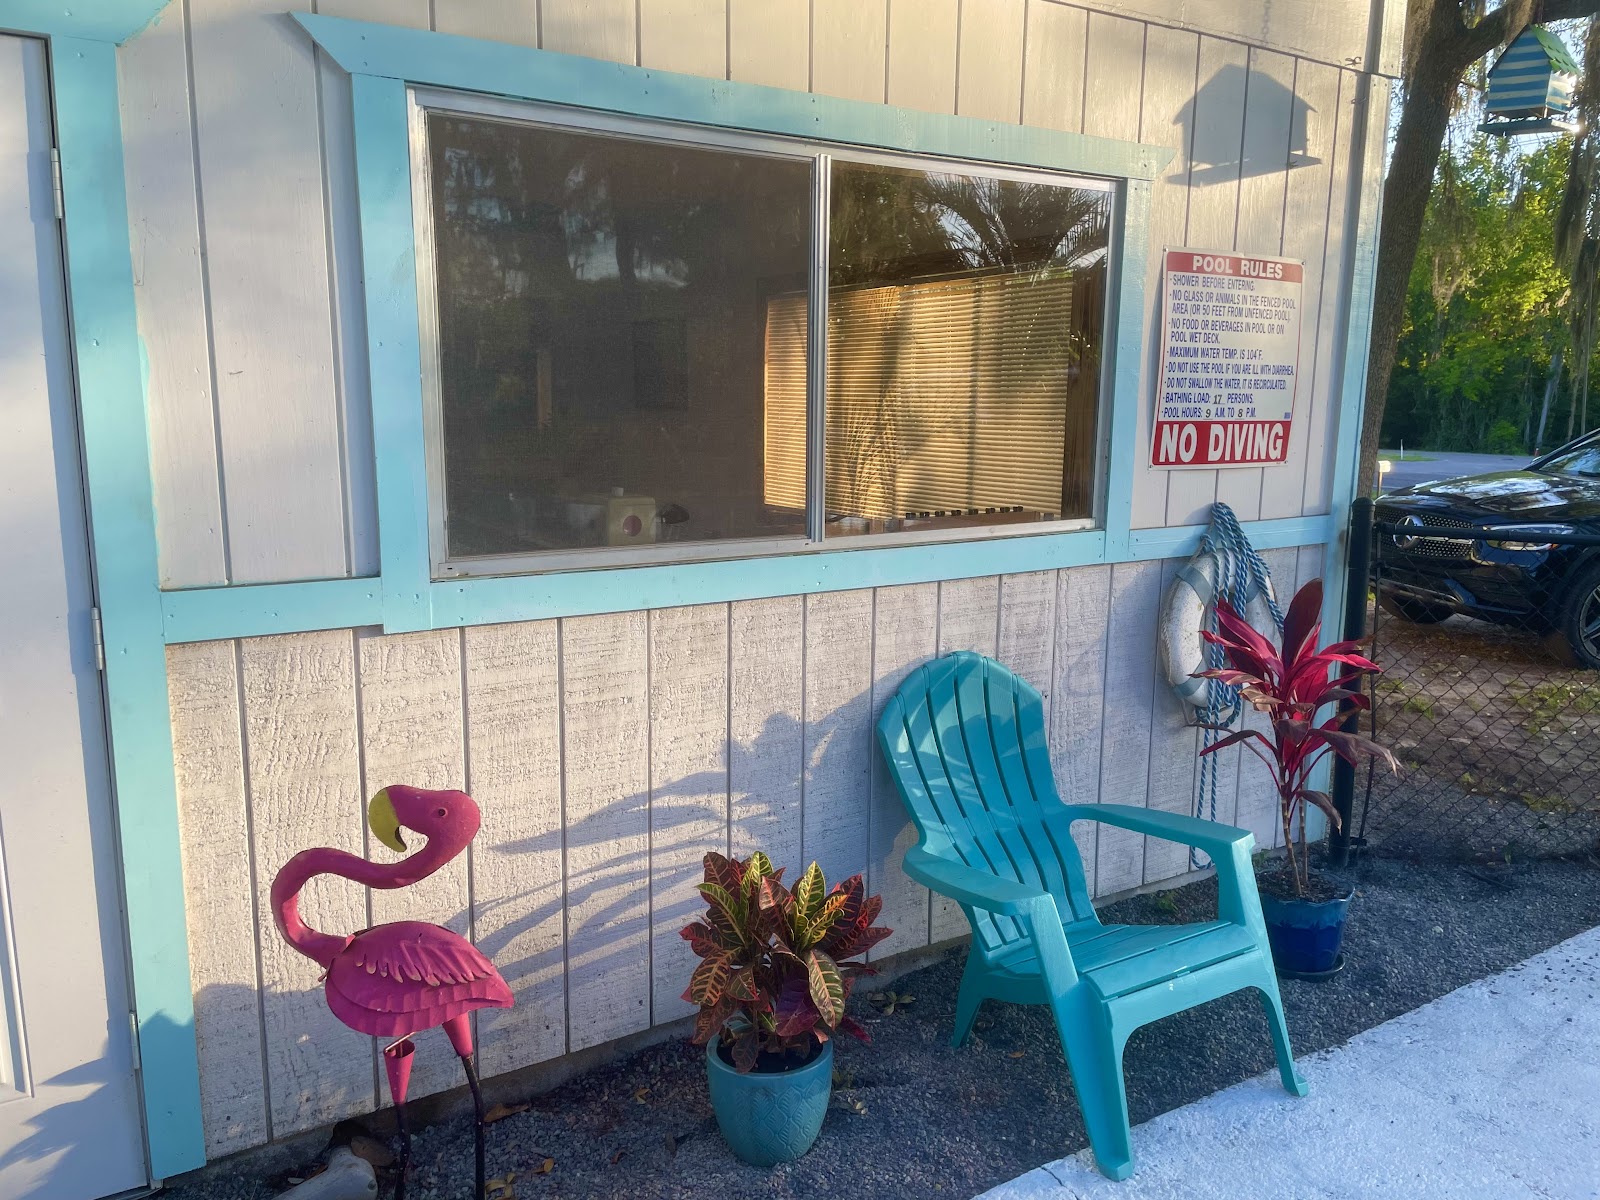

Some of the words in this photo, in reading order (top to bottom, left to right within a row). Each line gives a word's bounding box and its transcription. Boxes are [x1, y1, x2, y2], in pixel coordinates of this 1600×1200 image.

[1193, 256, 1232, 274] POOL
[1241, 260, 1282, 279] RULES
[1173, 274, 1199, 287] SHOWER
[1202, 277, 1225, 288] BEFORE
[1173, 290, 1181, 300] NO
[1184, 290, 1204, 302] GLASS
[1206, 292, 1214, 302] OR
[1216, 293, 1240, 304] ANIMALS
[1242, 295, 1247, 304] IN
[1250, 296, 1259, 306] THE
[1260, 296, 1280, 308] FENCED
[1282, 298, 1296, 309] POOL
[1172, 303, 1188, 314] AREA
[1190, 304, 1200, 316] (OR
[1202, 305, 1210, 315] 50
[1212, 306, 1226, 316] FEET
[1228, 307, 1243, 317] FROM
[1245, 308, 1272, 319] UNFENCED
[1171, 318, 1180, 329] NO
[1182, 319, 1199, 330] FOOD
[1201, 320, 1209, 330] OR
[1211, 321, 1243, 332] BEVERAGES
[1245, 322, 1250, 332] IN
[1252, 323, 1265, 333] POOL
[1268, 324, 1274, 334] OR
[1276, 324, 1284, 334] ON
[1171, 331, 1187, 342] POOL
[1190, 332, 1202, 342] WET
[1204, 333, 1220, 344] DECK.
[1170, 346, 1198, 358] MAXIMUM
[1200, 348, 1220, 358] WATER
[1222, 349, 1238, 359] TEMP.
[1240, 350, 1246, 359] IS
[1168, 362, 1176, 372] DO
[1178, 362, 1188, 372] NOT
[1190, 363, 1199, 373] USE
[1201, 363, 1210, 373] THE
[1212, 364, 1224, 374] POOL
[1226, 364, 1230, 374] IF
[1232, 364, 1241, 374] YOU
[1242, 364, 1251, 374] ARE
[1260, 365, 1271, 375] WITH
[1167, 378, 1174, 388] DO
[1176, 378, 1187, 388] NOT
[1188, 378, 1212, 389] SWALLOW
[1214, 378, 1222, 388] THE
[1242, 380, 1247, 389] IT
[1248, 380, 1252, 389] IS
[1166, 393, 1192, 403] BATHING
[1194, 393, 1210, 404] LOAD:
[1213, 395, 1222, 404] 17
[1164, 408, 1179, 417] POOL
[1182, 408, 1203, 418] HOURS:
[1206, 409, 1211, 418] 9
[1228, 408, 1234, 417] TO
[1238, 409, 1243, 418] 8
[1159, 424, 1197, 462] NO
[1208, 423, 1283, 461] DIVING
